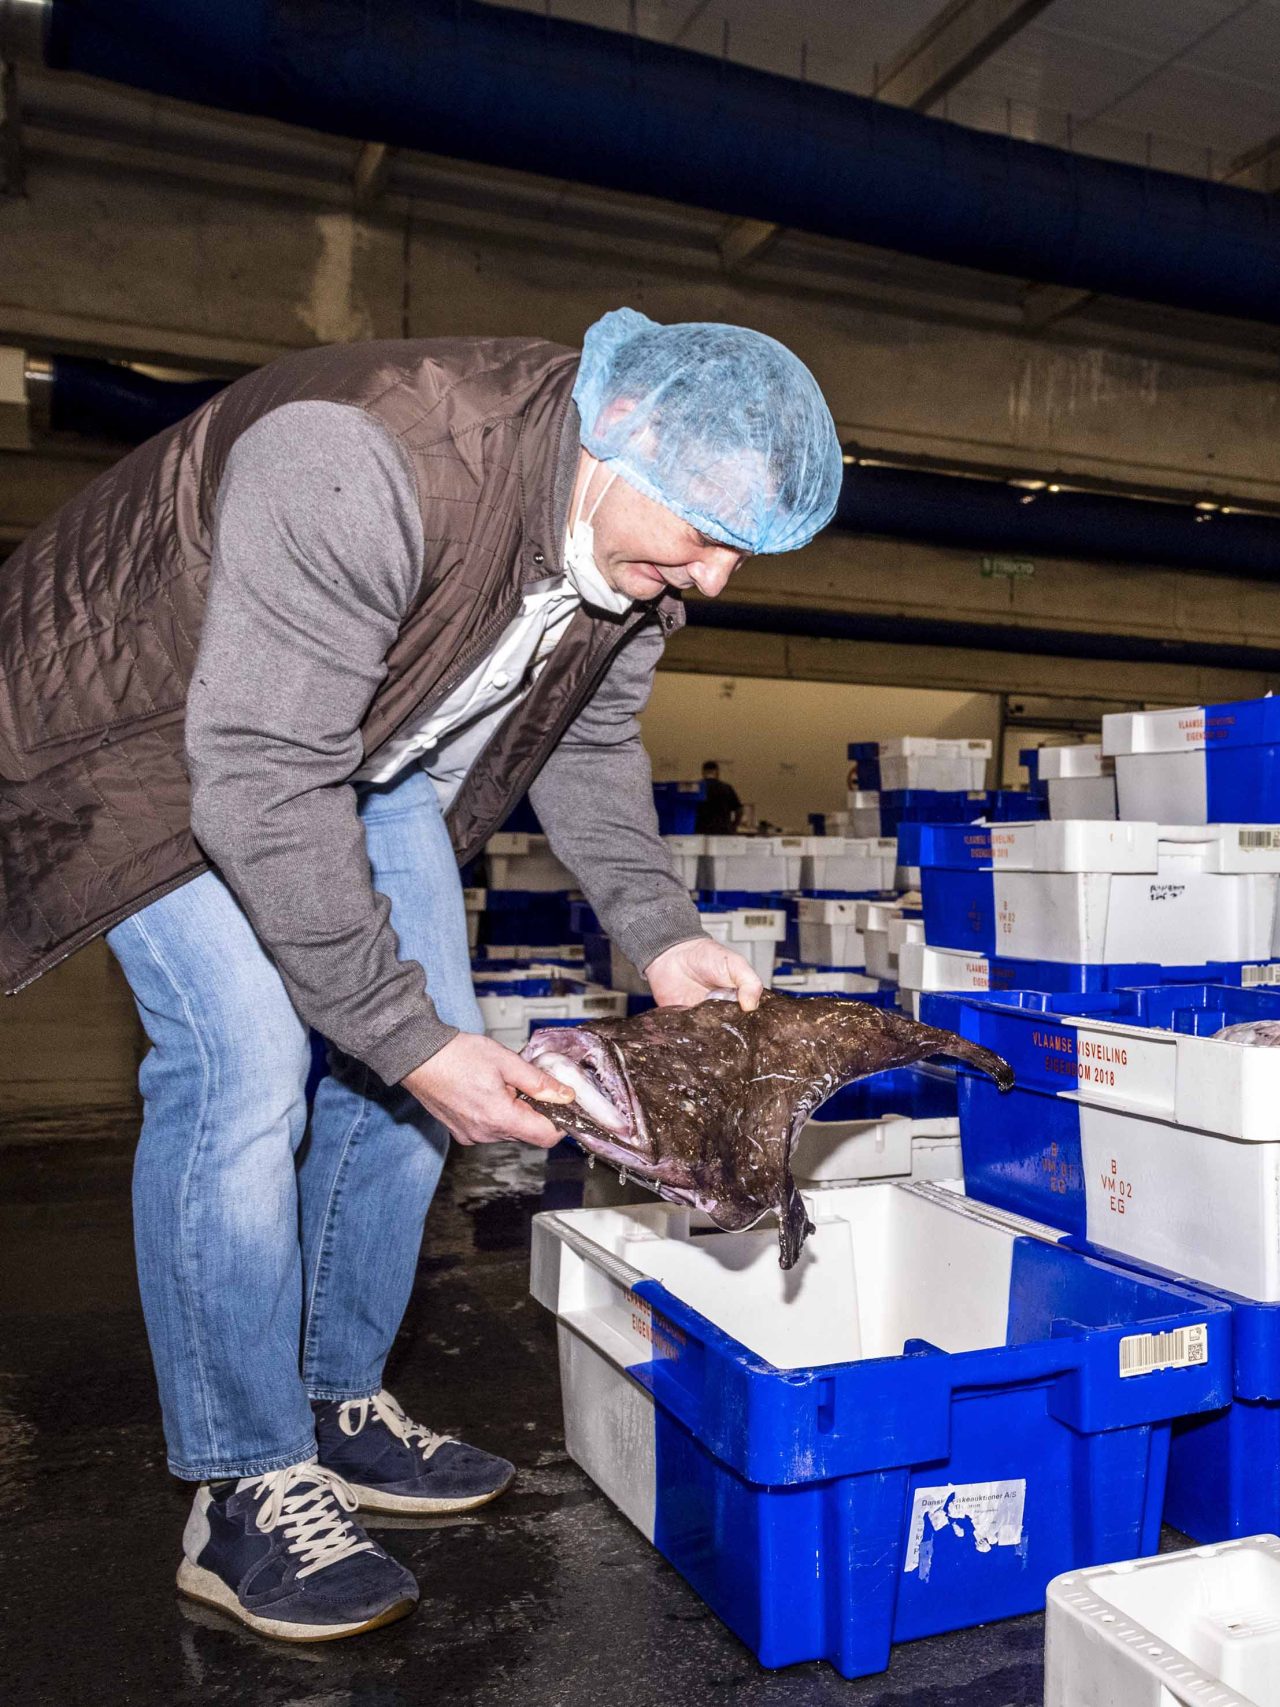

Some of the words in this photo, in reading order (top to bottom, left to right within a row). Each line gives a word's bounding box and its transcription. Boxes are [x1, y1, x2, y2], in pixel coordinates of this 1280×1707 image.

[1032, 1031, 1073, 1053] VLAAMSE
[1077, 1040, 1128, 1066] VISVEILING
[1045, 1055, 1091, 1081] EIGENDOM
[1094, 1067, 1115, 1087] 2018
[1111, 1159, 1117, 1175] B
[1101, 1173, 1116, 1193] VM
[1119, 1181, 1132, 1199] 02
[1110, 1195, 1125, 1214] EG
[1003, 1491, 1017, 1499] A/S
